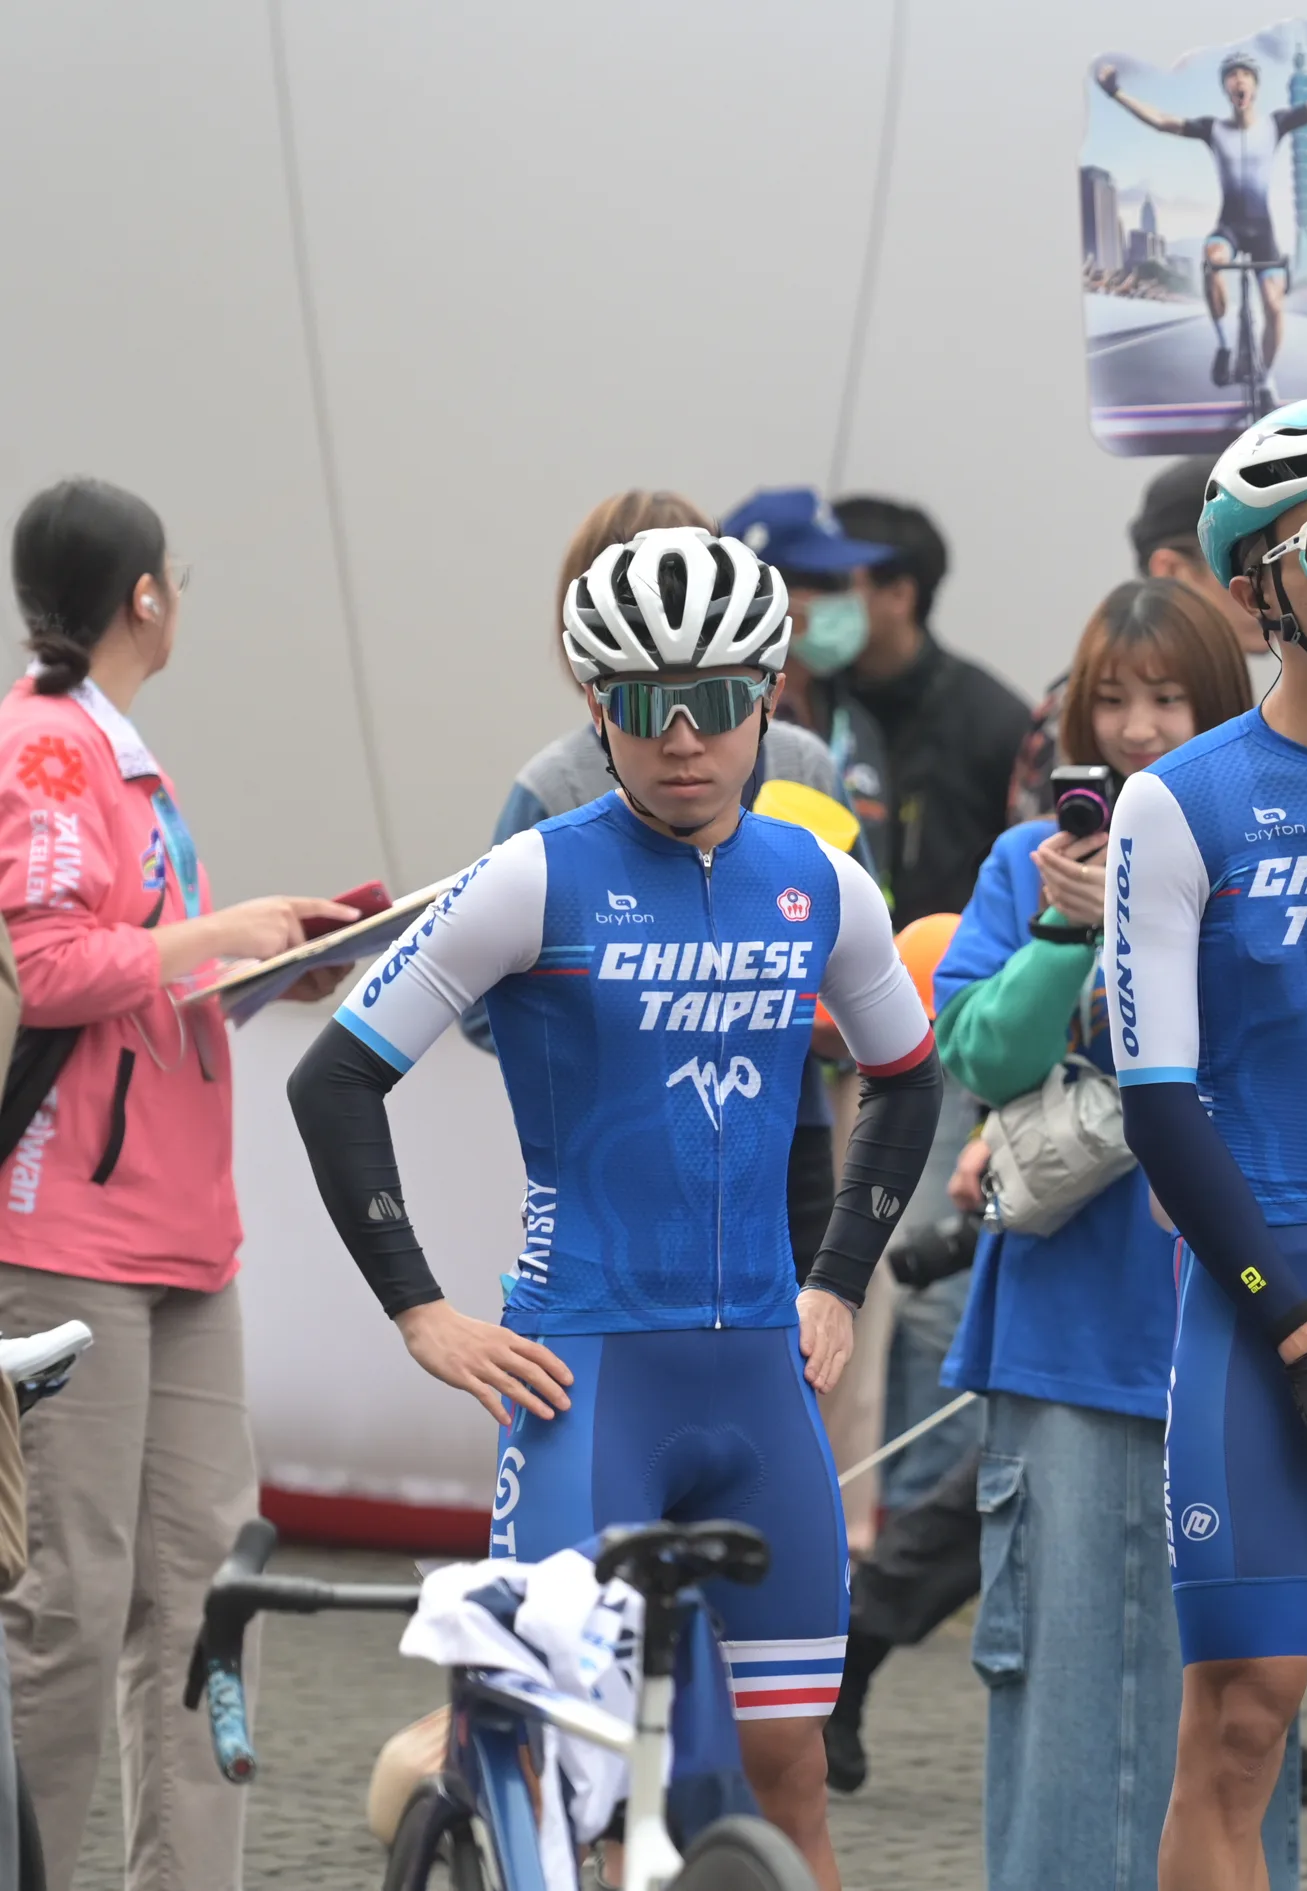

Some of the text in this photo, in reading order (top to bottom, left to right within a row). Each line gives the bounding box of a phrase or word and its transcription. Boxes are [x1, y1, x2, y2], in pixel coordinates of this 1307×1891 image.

[1244, 821, 1307, 843] bryton
[49, 811, 82, 909] TAIW
[595, 911, 655, 926] bryton
[598, 940, 813, 980] CHINESE
[1115, 837, 1140, 1058] VOLANDO
[638, 991, 798, 1033] TAIPEI
